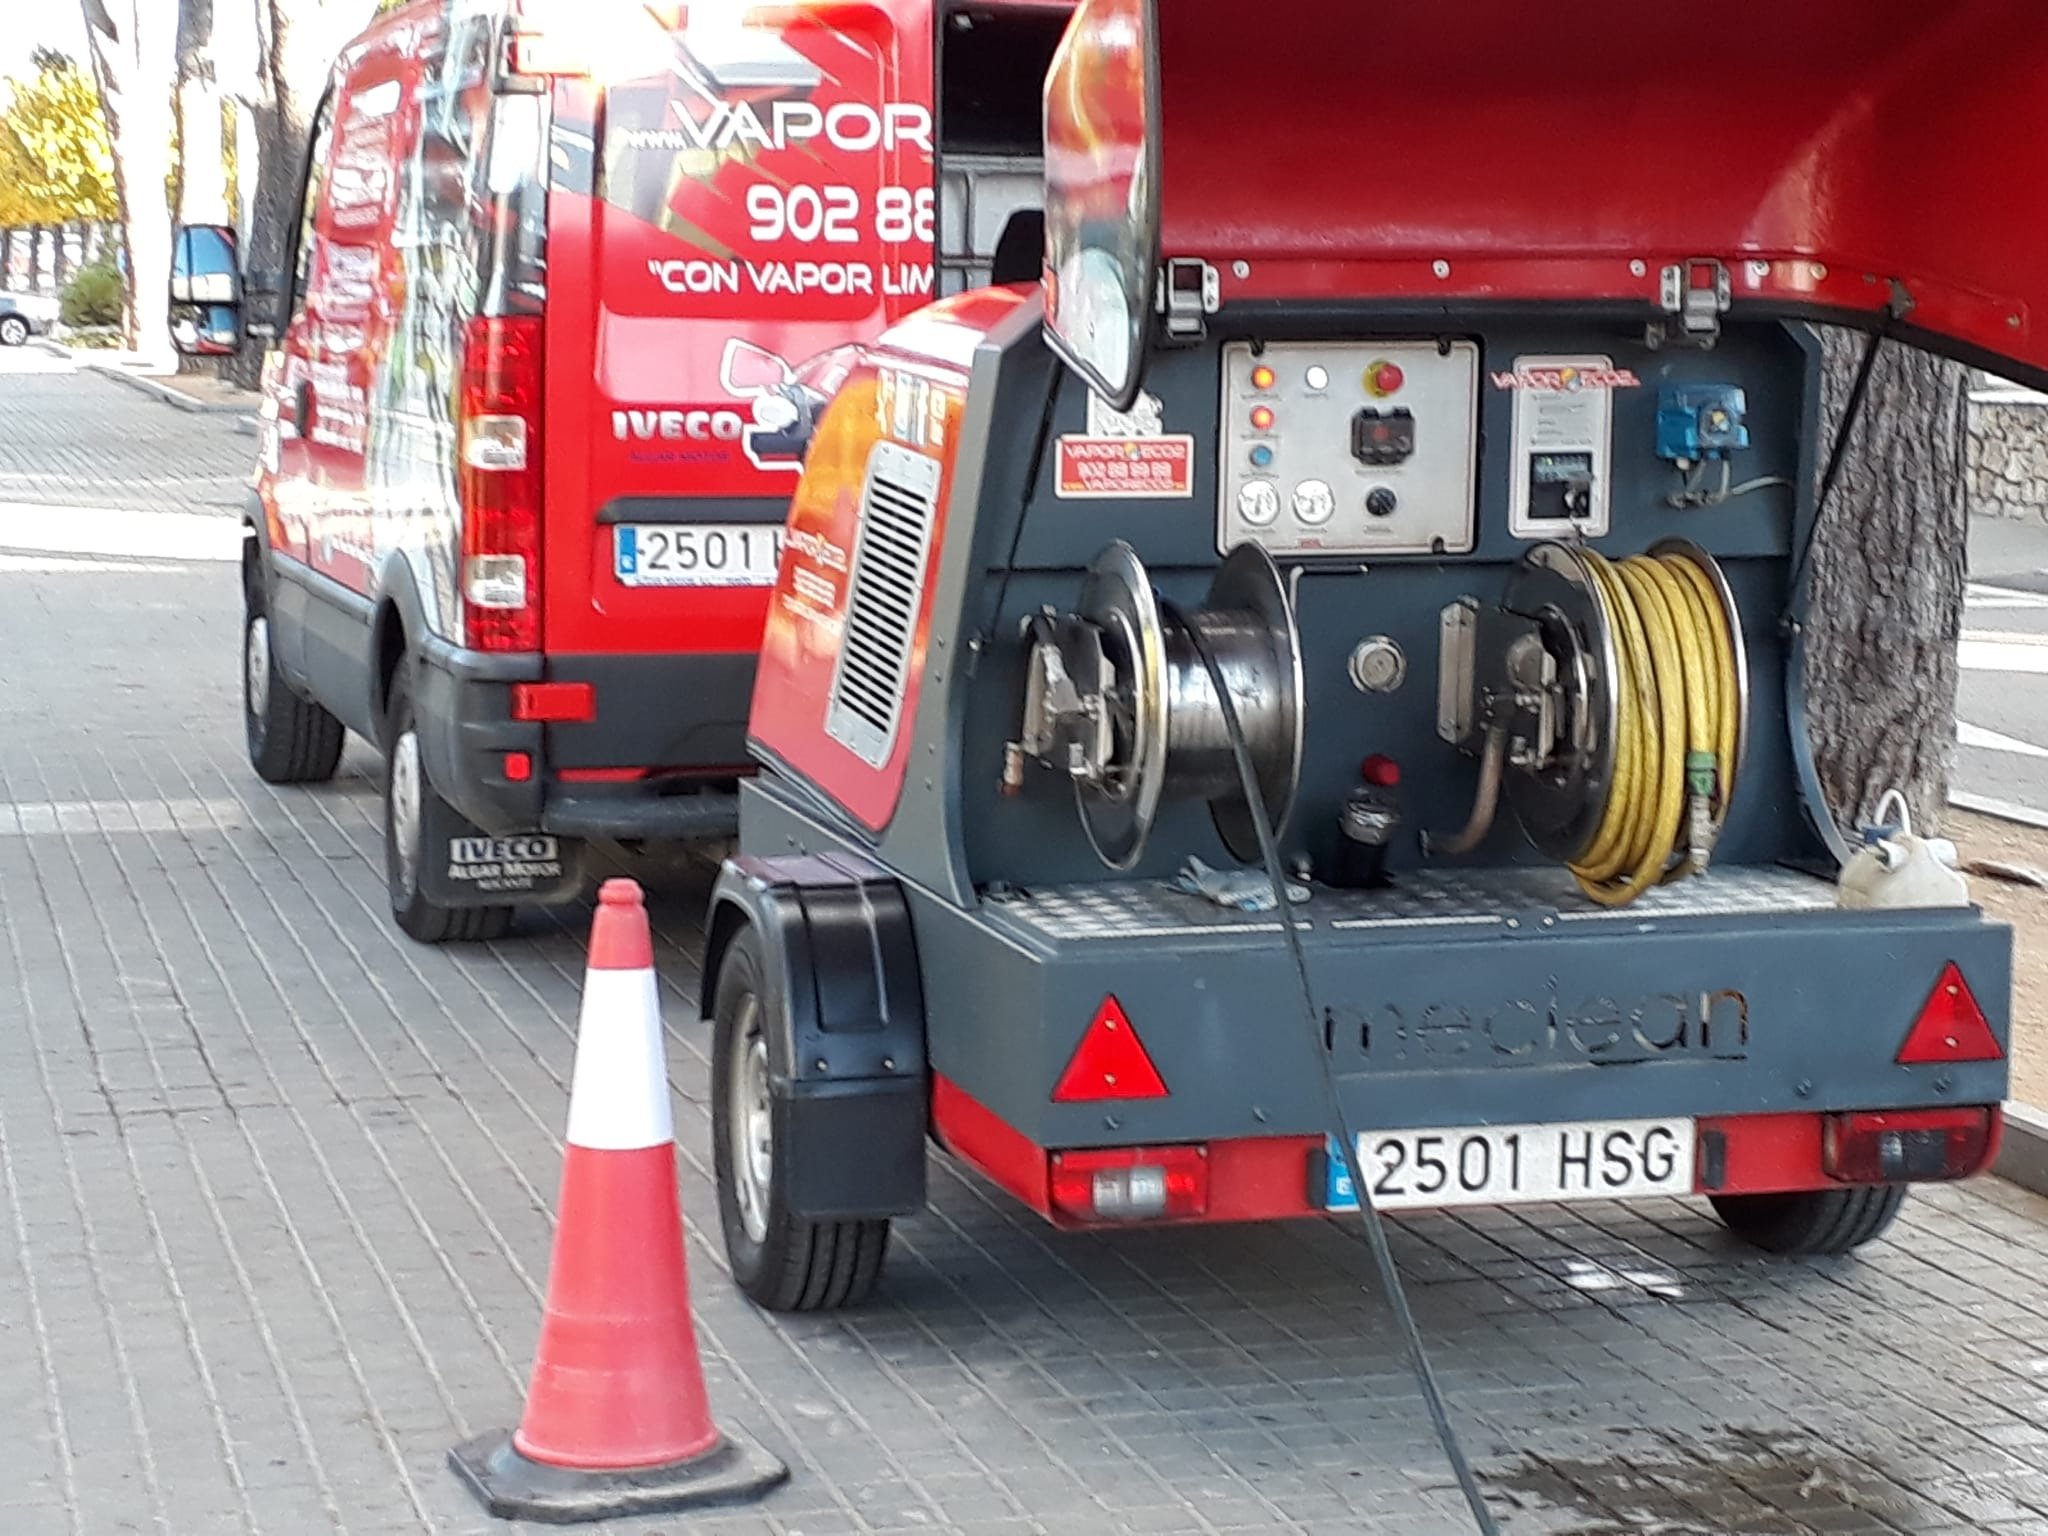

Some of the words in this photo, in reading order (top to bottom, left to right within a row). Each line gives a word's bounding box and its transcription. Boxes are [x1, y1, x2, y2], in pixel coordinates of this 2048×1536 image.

[747, 184, 860, 242] 902
[745, 260, 873, 295] VAPOR
[612, 411, 743, 440] IVECO
[648, 532, 751, 570] 2501
[460, 840, 546, 857] IVECO
[1373, 1132, 1520, 1195] 2501
[1559, 1126, 1676, 1189] HSG
